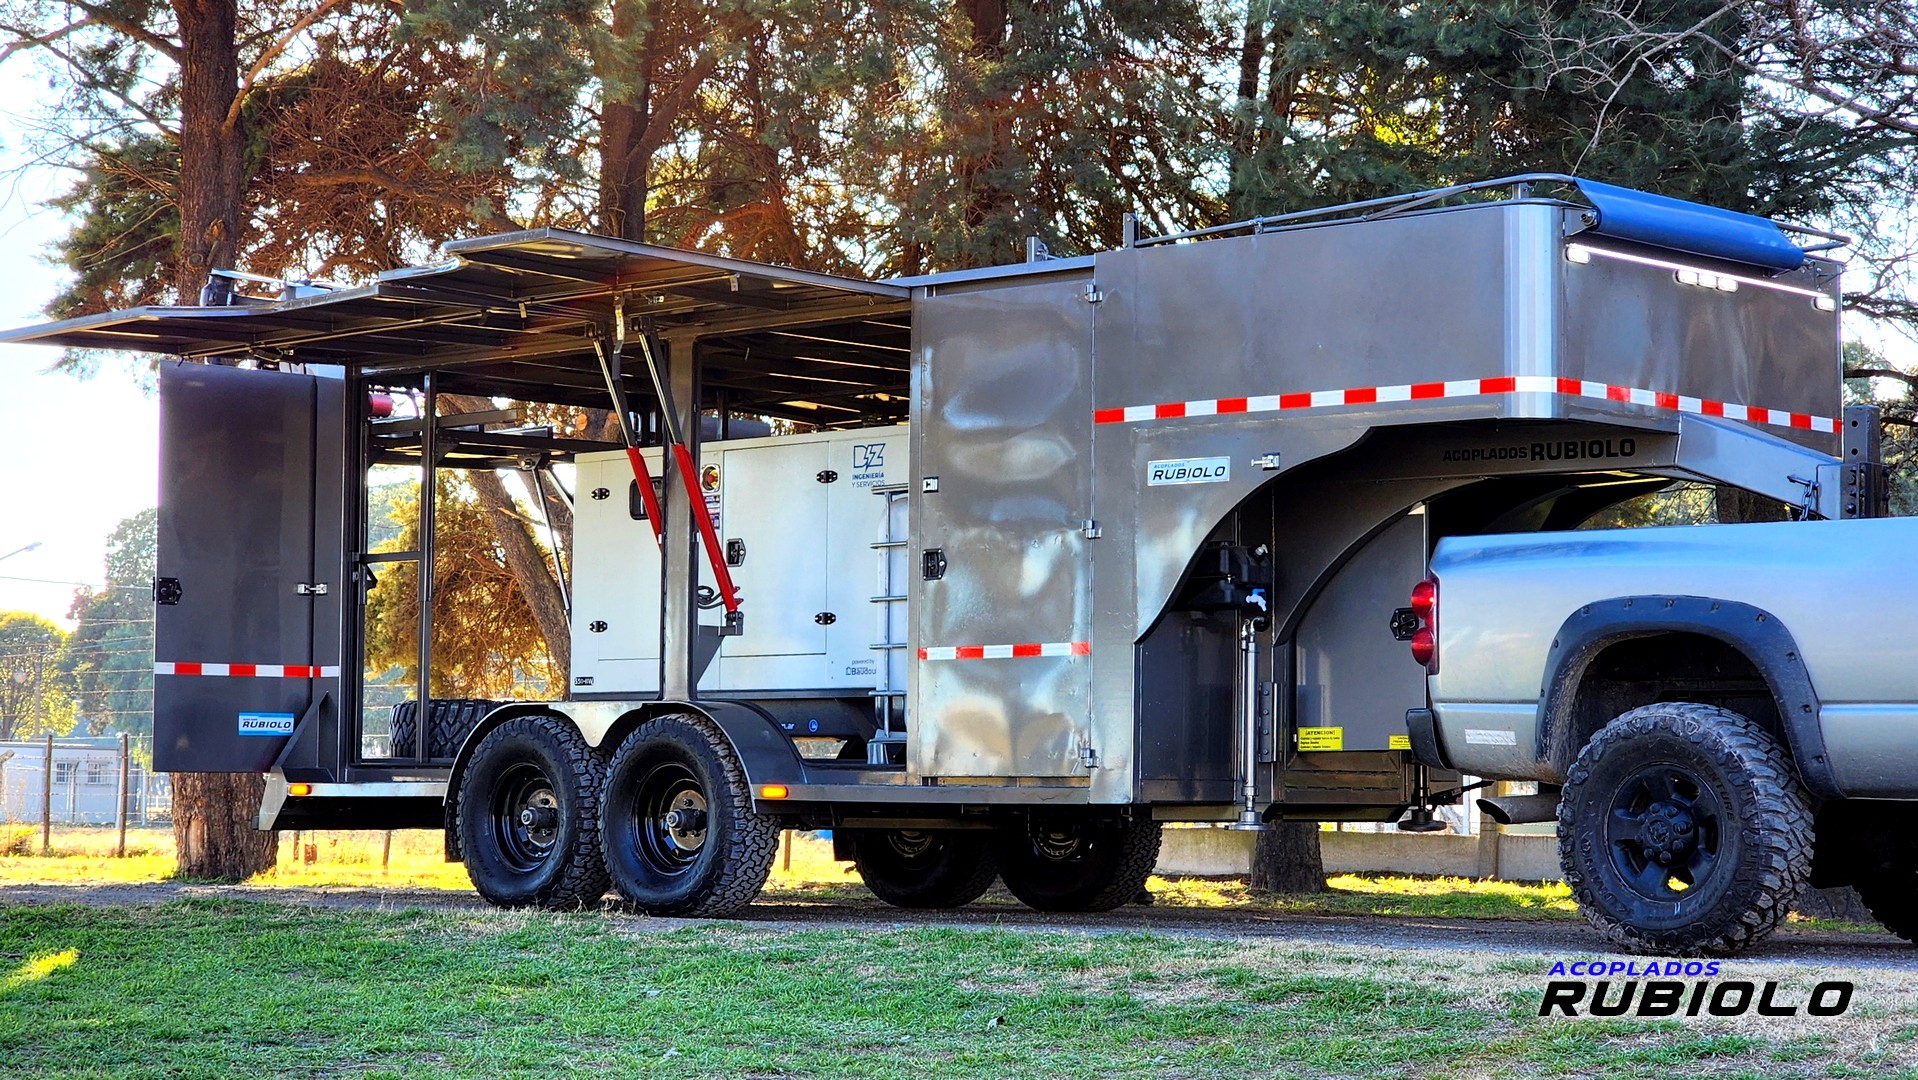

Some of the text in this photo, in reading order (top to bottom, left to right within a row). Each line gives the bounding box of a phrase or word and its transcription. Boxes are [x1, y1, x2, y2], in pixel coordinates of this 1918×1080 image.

[1443, 438, 1636, 462] ACOPLADOS RUBIOLO
[1152, 466, 1226, 480] RUBIOLO
